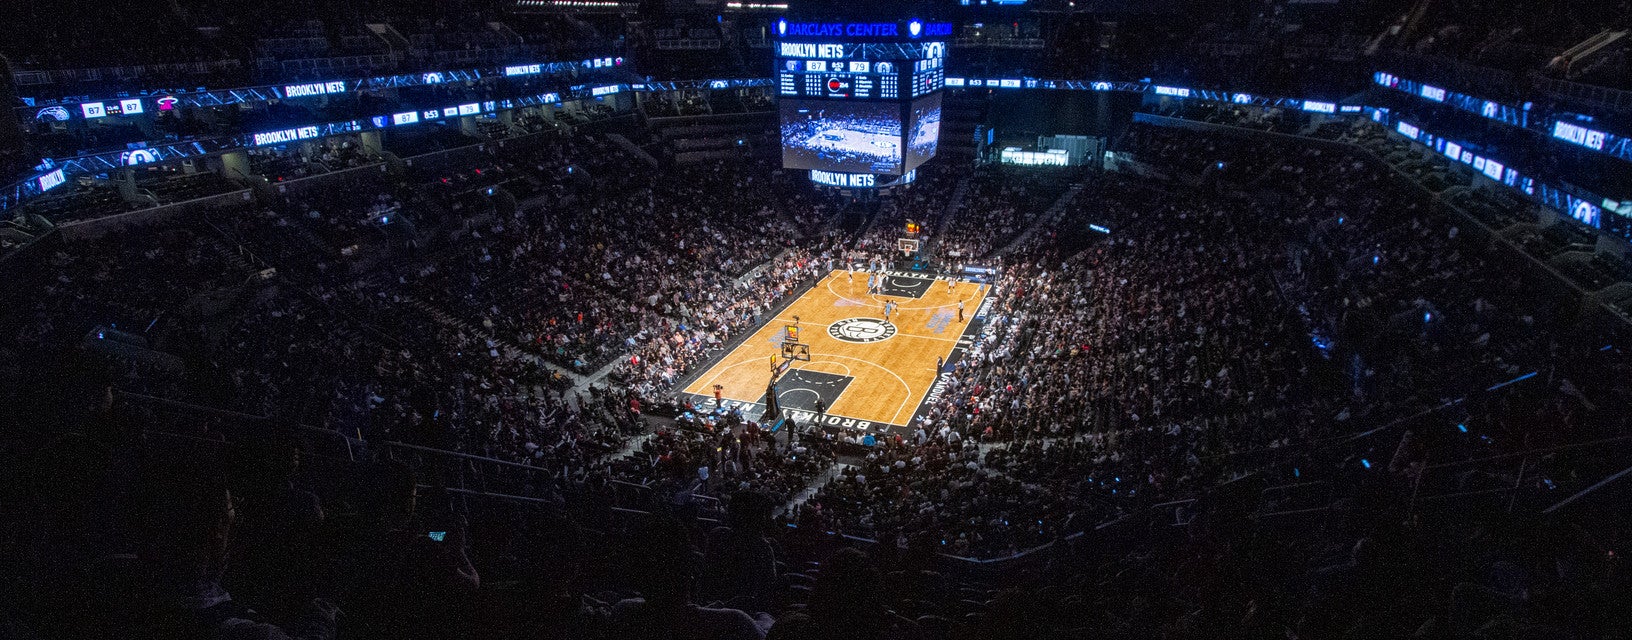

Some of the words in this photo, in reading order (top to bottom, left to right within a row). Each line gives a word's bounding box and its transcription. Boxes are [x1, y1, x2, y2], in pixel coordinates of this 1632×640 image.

[789, 23, 843, 36] BARCLAYS
[846, 23, 899, 36] CENTER
[781, 43, 816, 57] BROOKLYN
[818, 44, 843, 58] NETS
[286, 83, 326, 98] BROOKLYN
[325, 81, 345, 94] NETS
[88, 106, 100, 115] 87
[126, 103, 138, 111] 87
[254, 128, 298, 146] BROOKLYN
[298, 126, 319, 139] NETS
[811, 169, 847, 186] BROOKLYN
[849, 173, 875, 187] NETS
